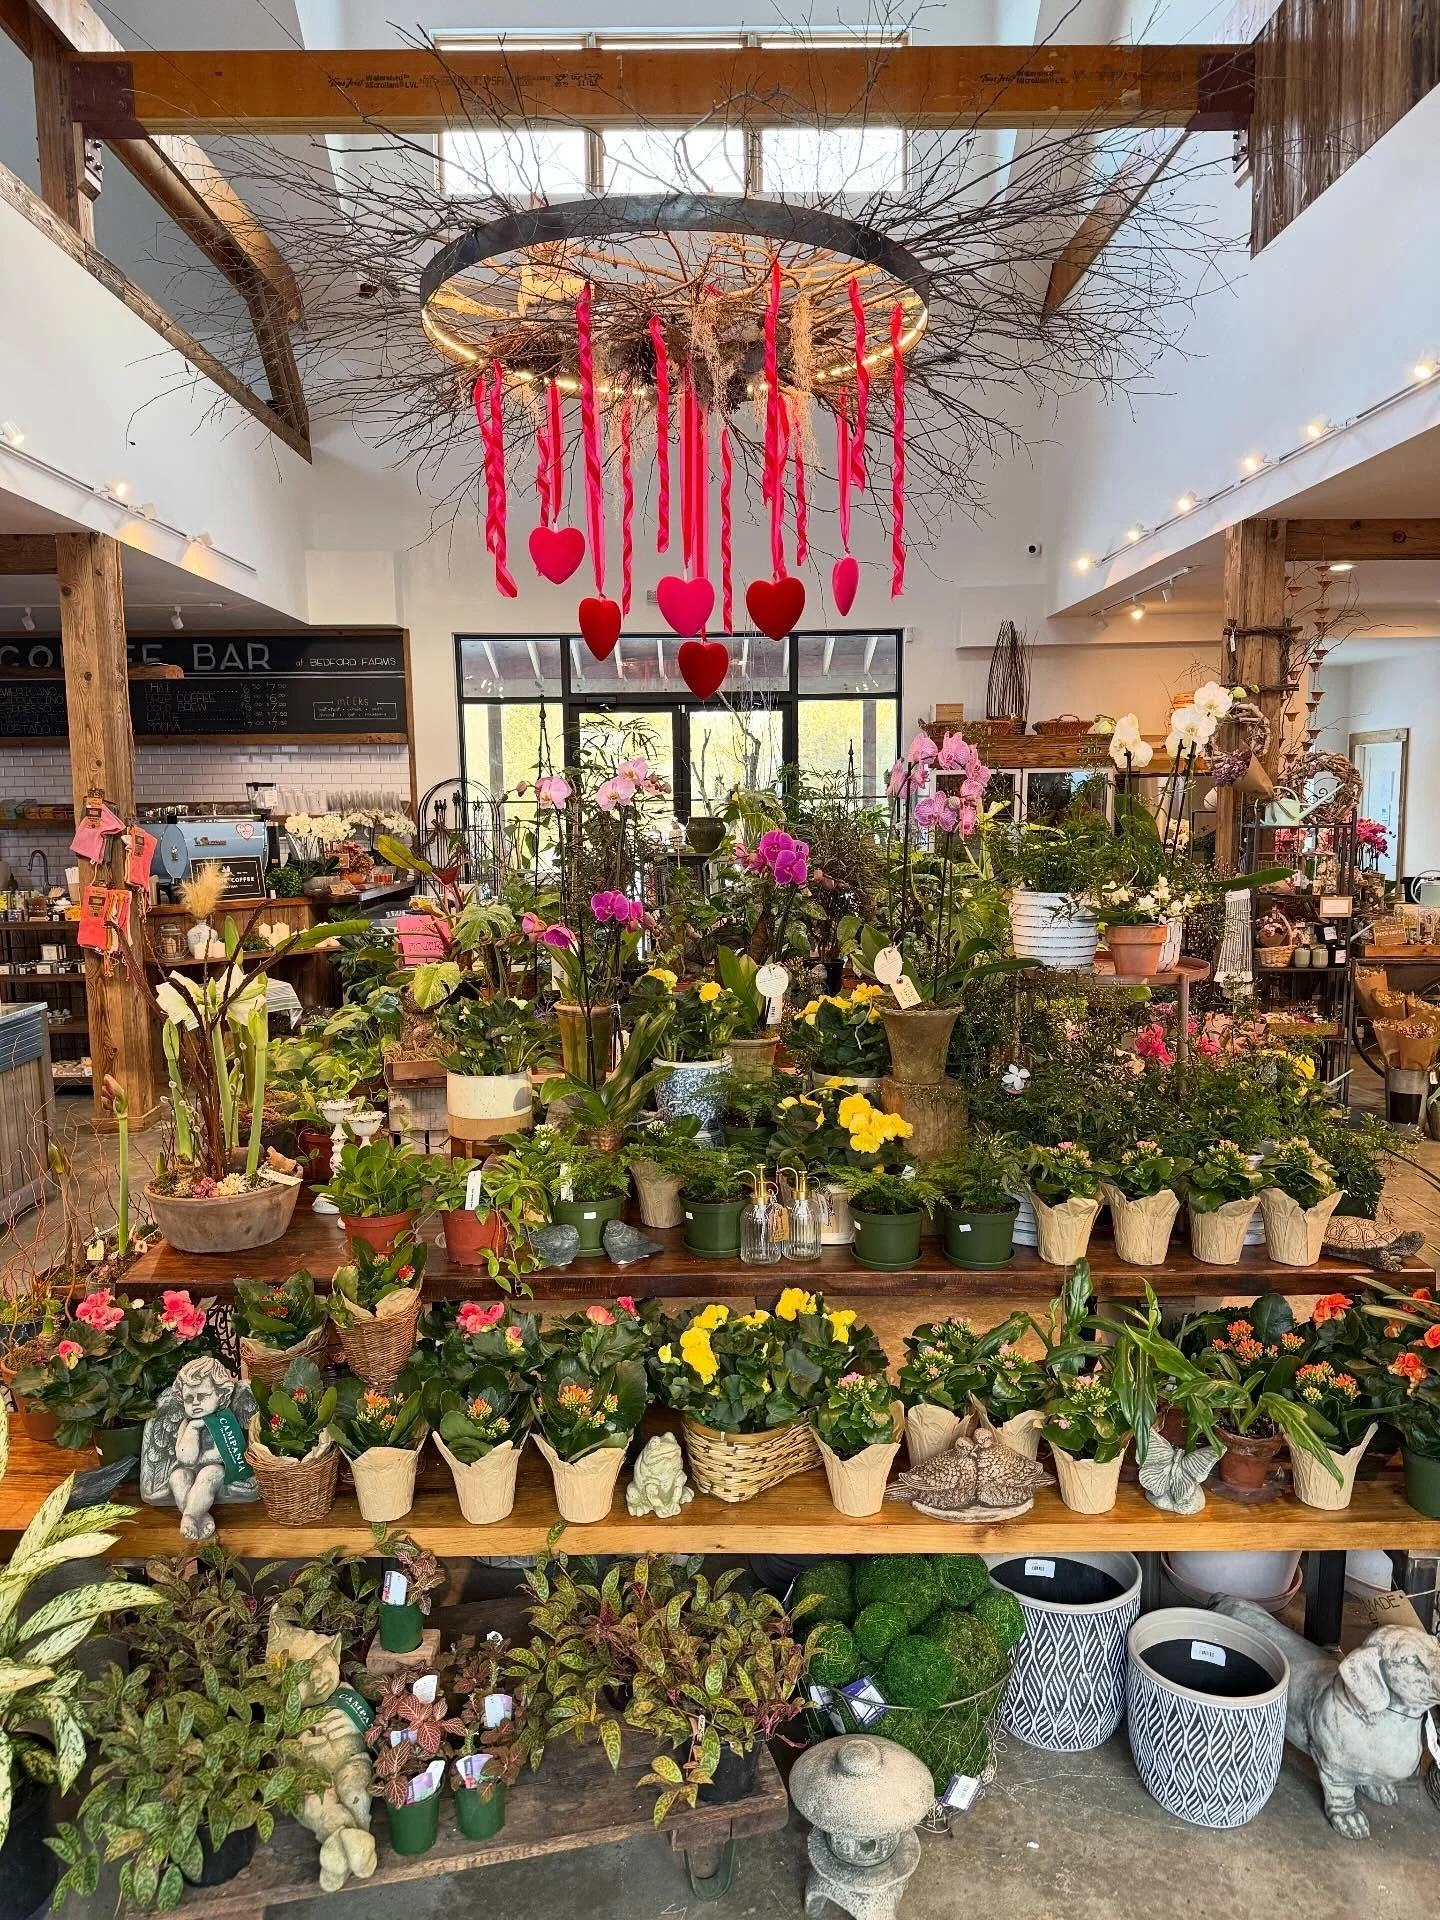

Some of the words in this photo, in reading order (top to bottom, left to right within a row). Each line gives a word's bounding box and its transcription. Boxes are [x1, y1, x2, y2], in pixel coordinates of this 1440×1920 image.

[193, 644, 271, 670] BAR
[309, 658, 356, 666] BEDFORD
[361, 657, 396, 665] FARMS
[220, 1417, 246, 1473] CAMPANIA
[1361, 1594, 1401, 1612] MADE
